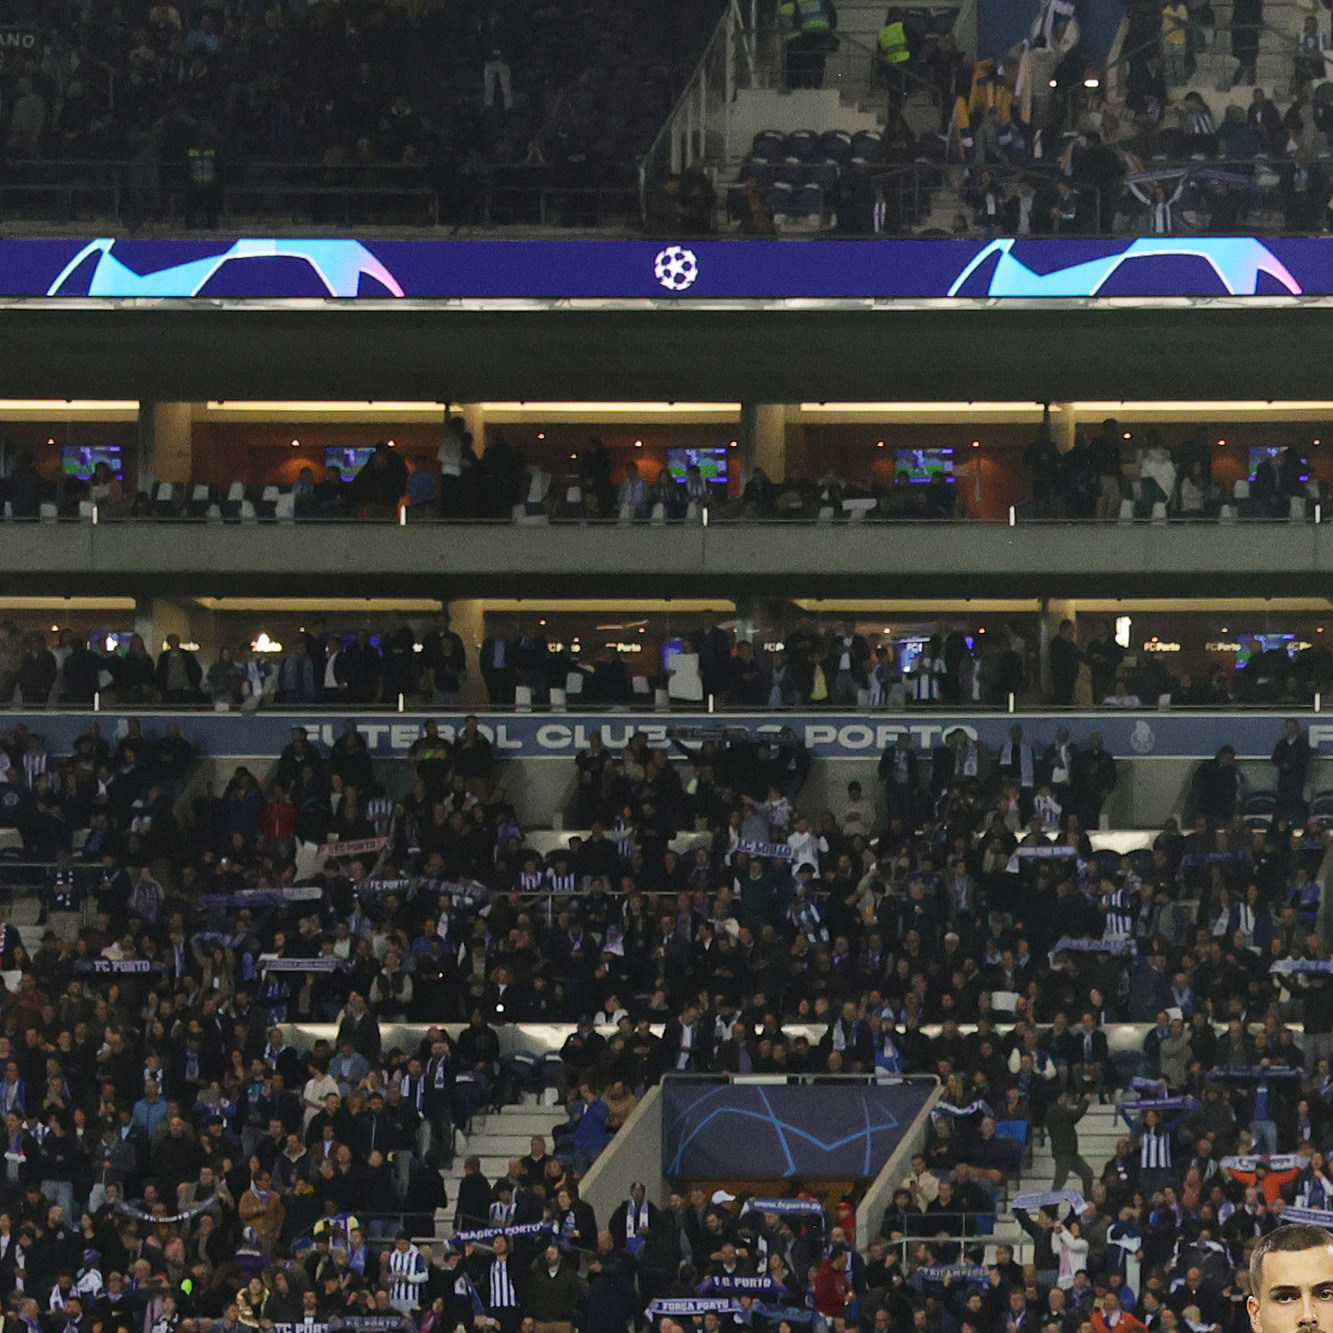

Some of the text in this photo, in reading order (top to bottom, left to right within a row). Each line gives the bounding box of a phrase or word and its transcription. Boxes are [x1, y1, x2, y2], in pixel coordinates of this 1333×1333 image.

[94, 960, 151, 972] FC PORTO
[734, 1276, 772, 1288] PORTO
[697, 1299, 729, 1311] PORTO
